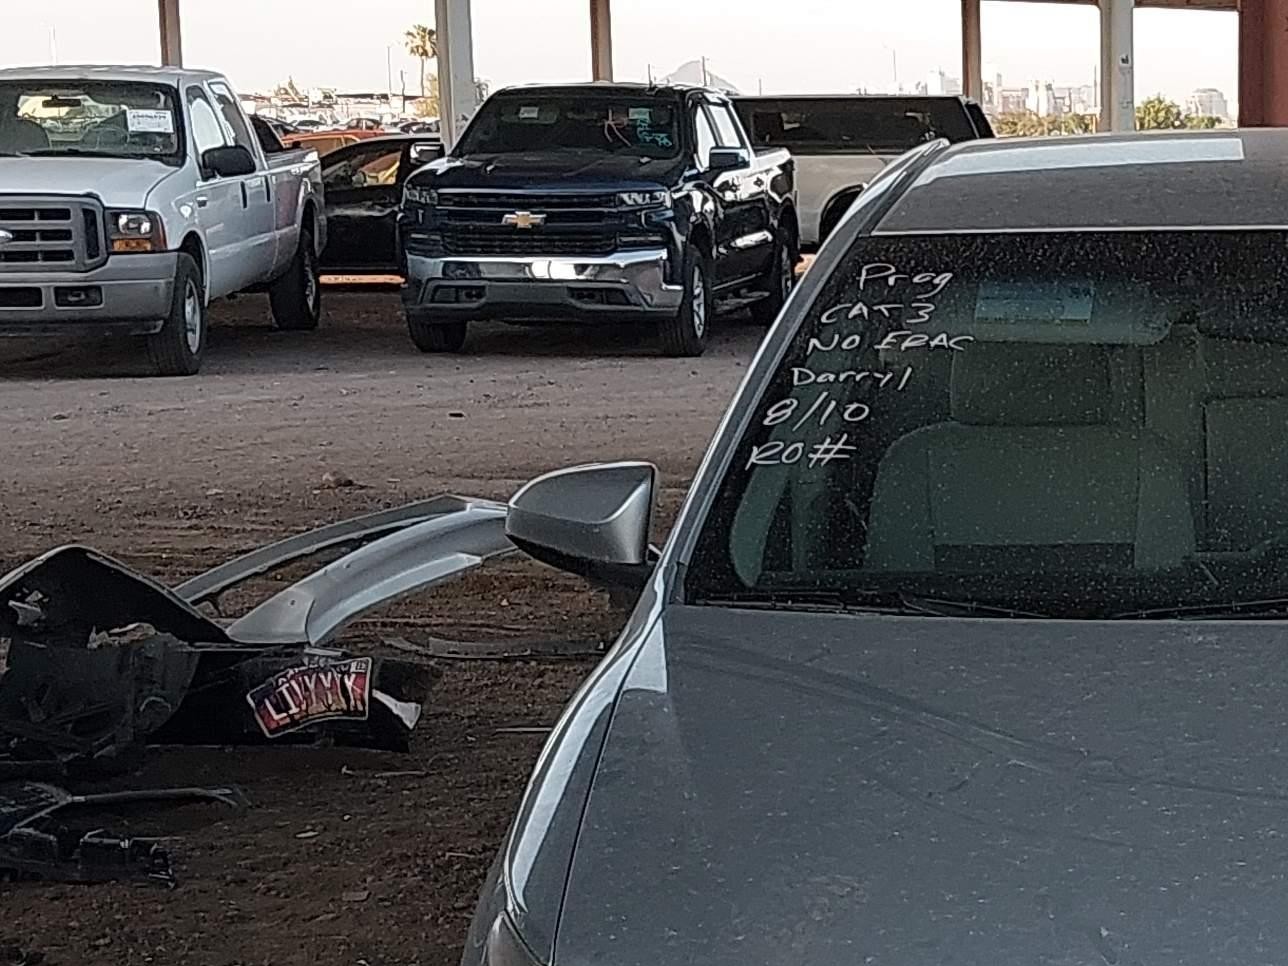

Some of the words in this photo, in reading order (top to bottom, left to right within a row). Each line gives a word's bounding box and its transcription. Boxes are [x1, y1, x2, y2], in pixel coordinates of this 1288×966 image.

[859, 263, 953, 299] Prog
[820, 302, 902, 323] CAT
[906, 303, 935, 323] 3
[806, 334, 861, 355] NO
[763, 391, 869, 431] 8/10
